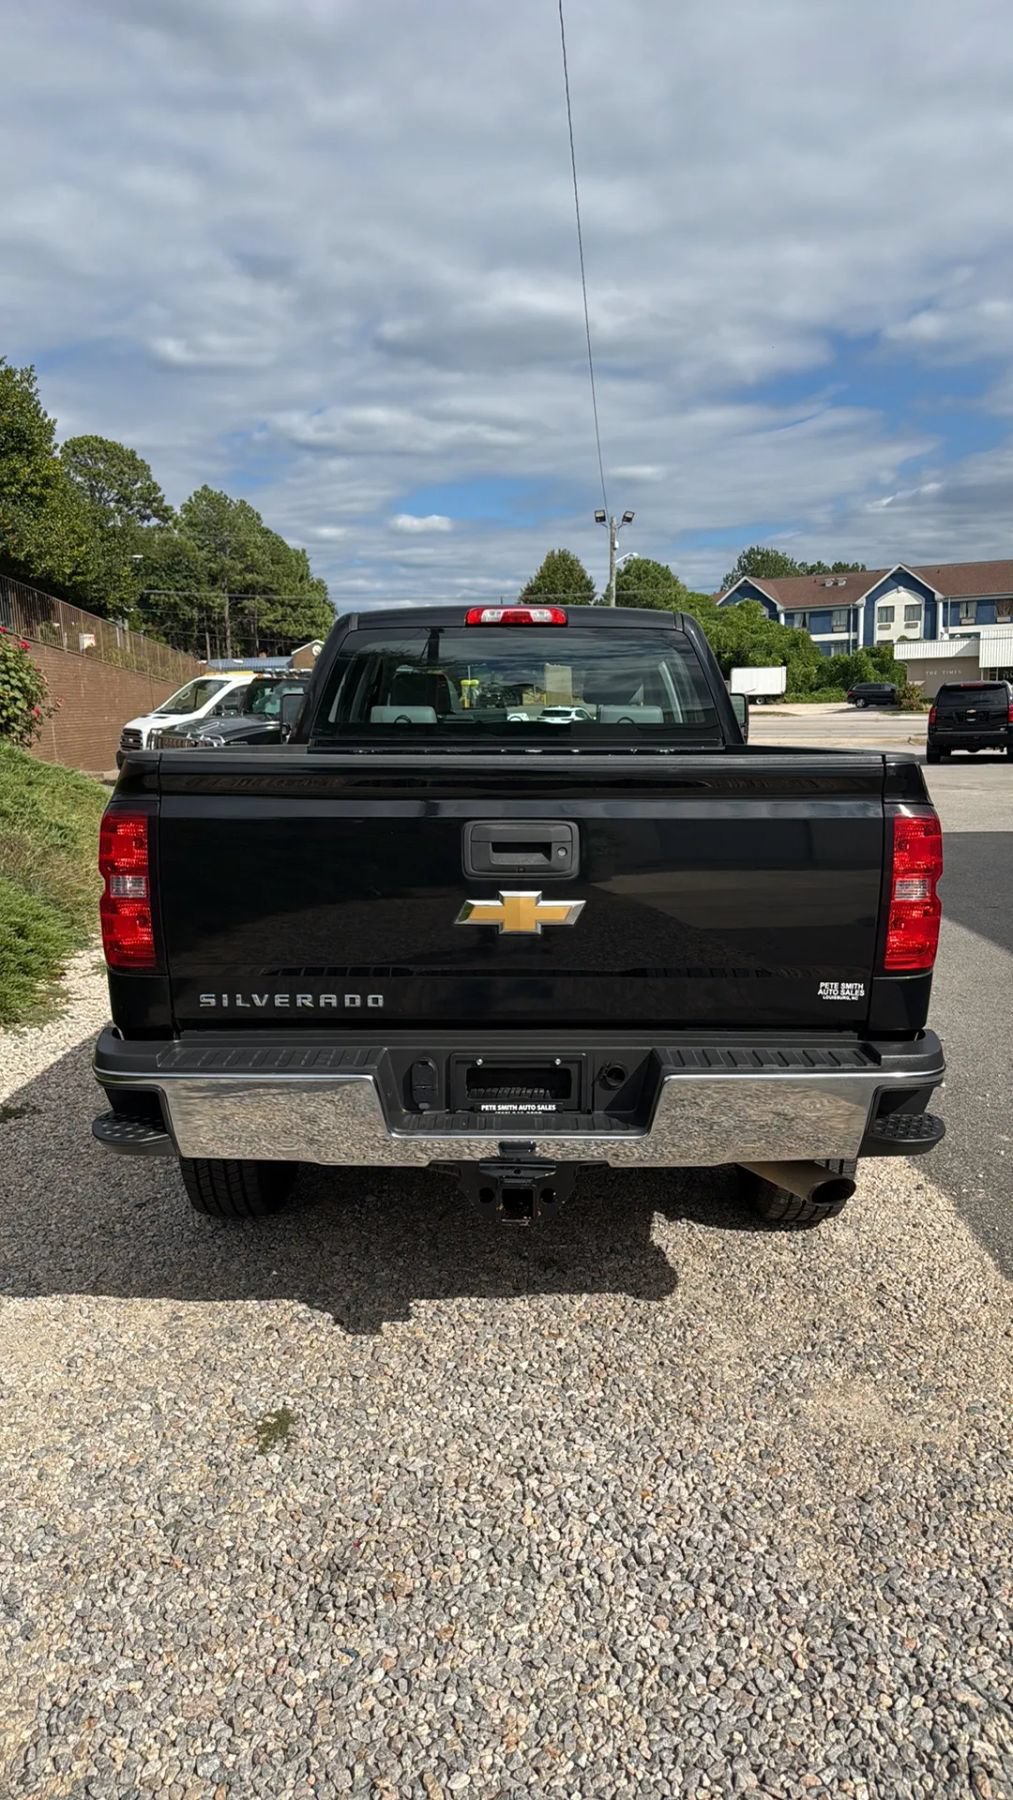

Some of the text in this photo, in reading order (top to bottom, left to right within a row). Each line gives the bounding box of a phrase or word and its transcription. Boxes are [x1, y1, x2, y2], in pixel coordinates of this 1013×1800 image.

[819, 982, 864, 990] PETE SMITH
[199, 993, 385, 1008] SILVERADO
